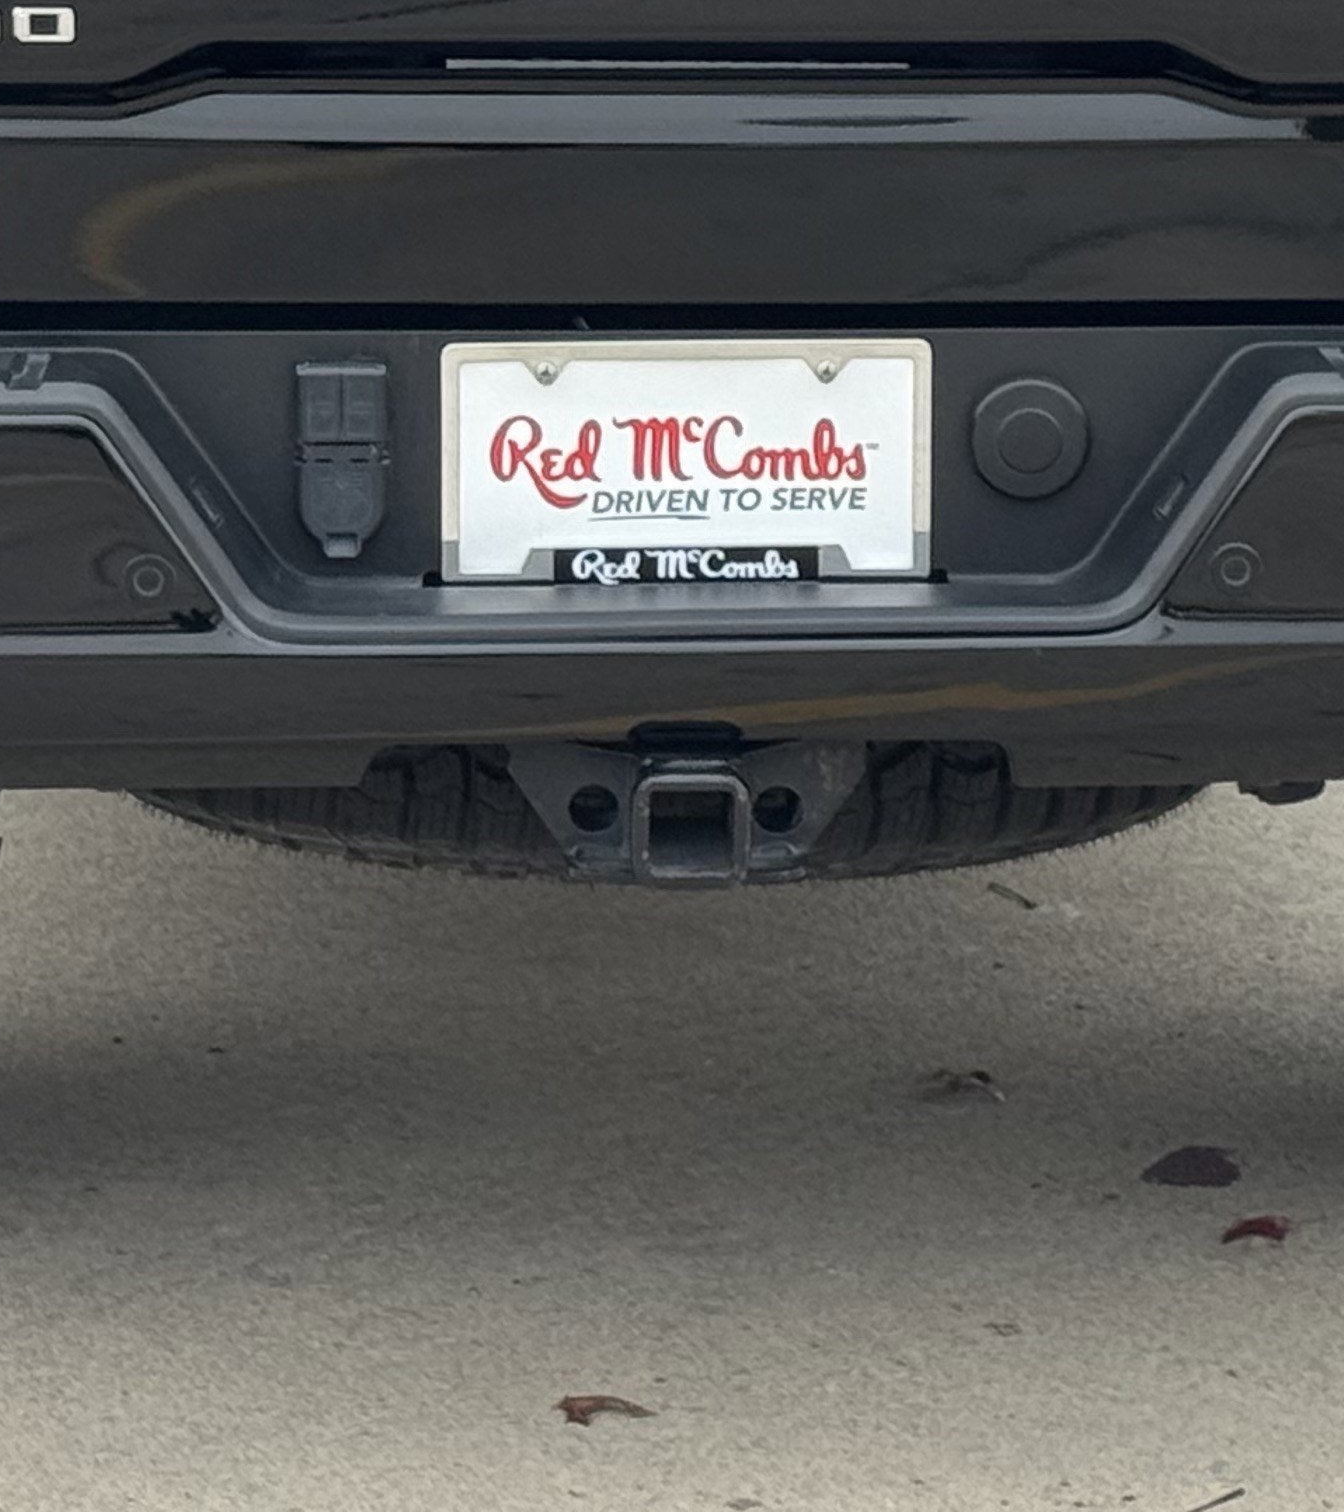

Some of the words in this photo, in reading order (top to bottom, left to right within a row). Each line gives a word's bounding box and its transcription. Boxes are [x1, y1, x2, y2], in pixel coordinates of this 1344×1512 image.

[489, 414, 603, 510] Red
[591, 489, 709, 514] DRIVEN
[721, 488, 762, 512] TO
[770, 487, 868, 512] SERVE
[571, 548, 641, 585] Red
[644, 548, 800, 579] McCombs
